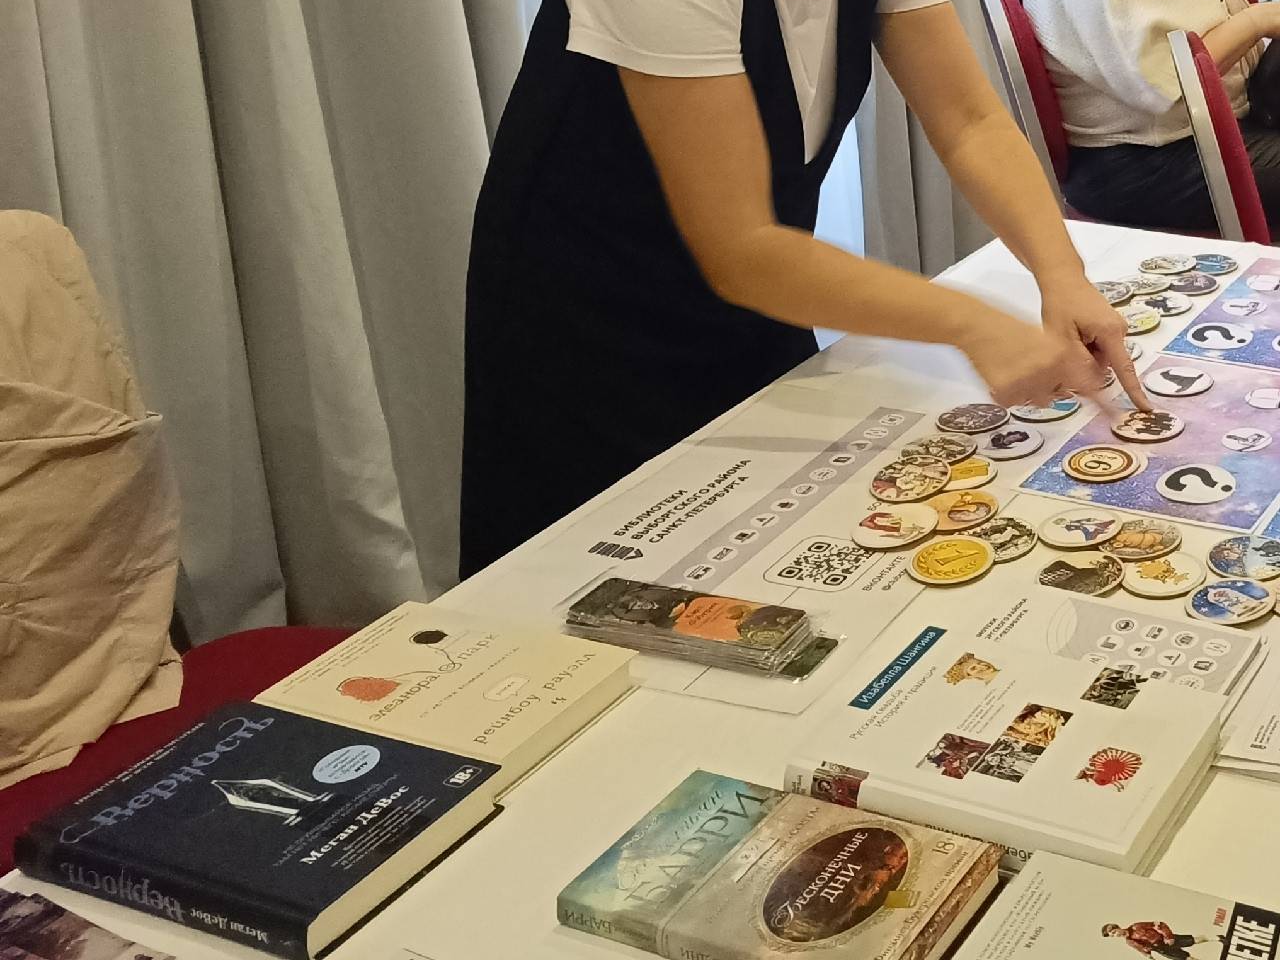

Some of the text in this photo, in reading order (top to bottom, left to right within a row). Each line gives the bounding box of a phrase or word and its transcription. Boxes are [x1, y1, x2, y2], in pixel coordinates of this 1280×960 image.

[613, 489, 688, 536] БИБЛИОТЕКИ
[631, 460, 751, 540] ВЫБОРГСКОГО РАЙОНА
[649, 476, 749, 543] САНКТ-ПЕТЕРБУРГА
[369, 673, 441, 721] элеанора
[473, 693, 541, 745] рейнбоу
[543, 653, 597, 691] рауэлл
[858, 631, 936, 704] Изабелла Шангина
[68, 717, 275, 836] Верность
[449, 767, 476, 785] 18+
[300, 824, 359, 864] Меган
[355, 785, 410, 825] ДеВос
[624, 790, 772, 904] БАРРИ
[820, 863, 862, 903] ДНИ
[230, 921, 270, 945] Меган
[1226, 914, 1276, 960] ЕТКЕ
